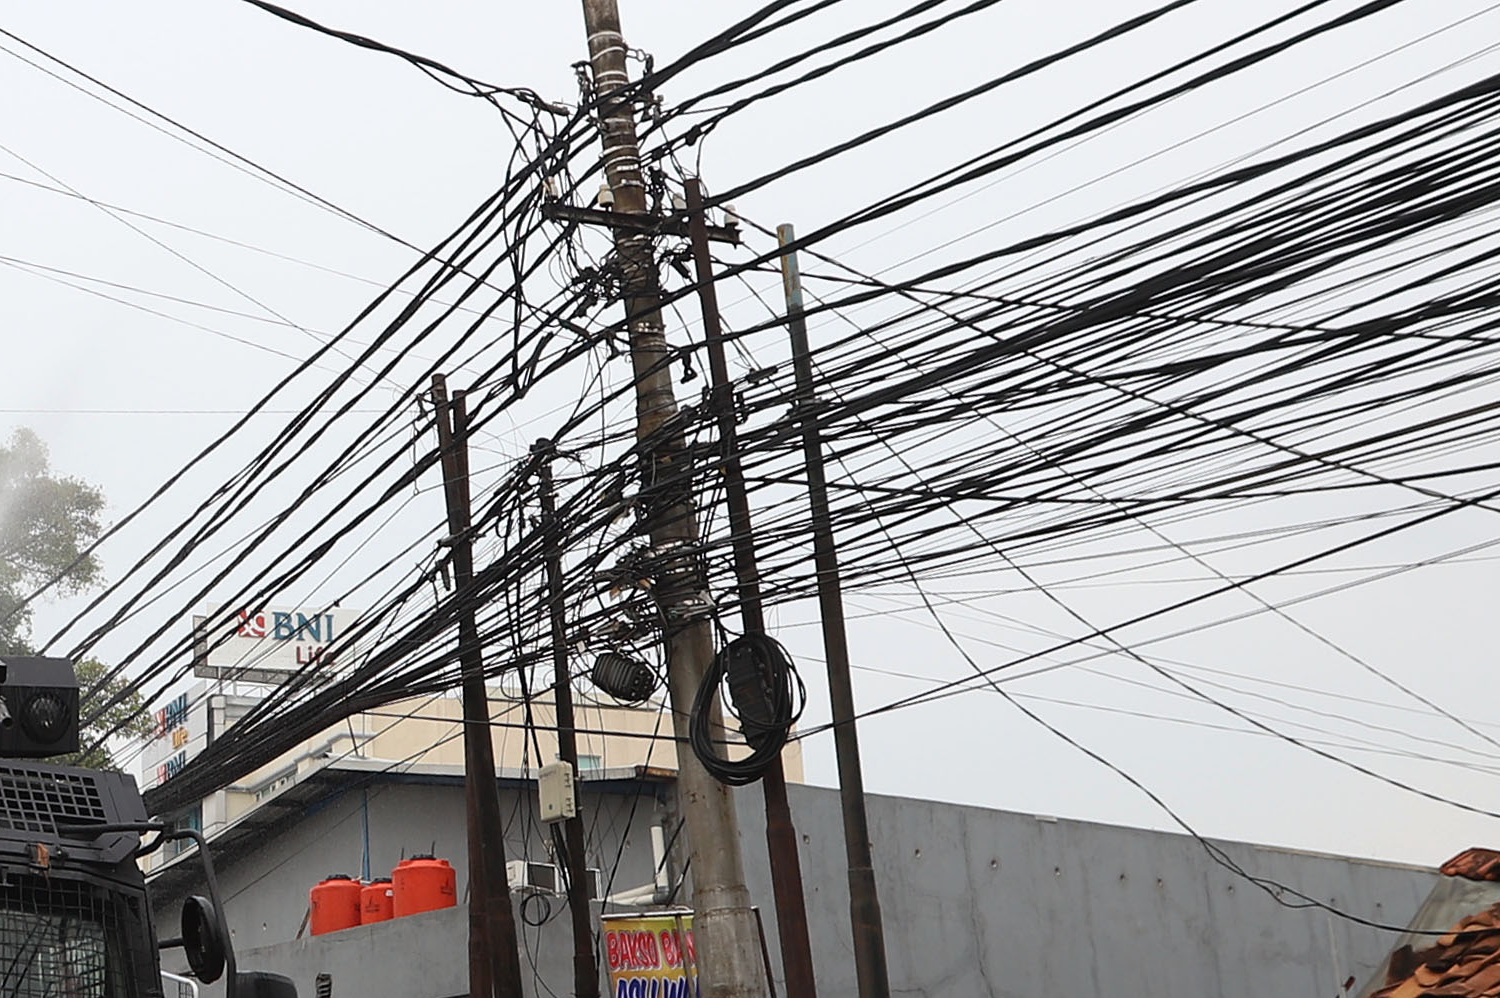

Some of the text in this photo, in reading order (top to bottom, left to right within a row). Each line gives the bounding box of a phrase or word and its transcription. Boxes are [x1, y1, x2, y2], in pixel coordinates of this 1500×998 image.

[272, 611, 335, 642] BNI
[296, 645, 336, 667] Life
[606, 929, 697, 970] BAKSO BAN
